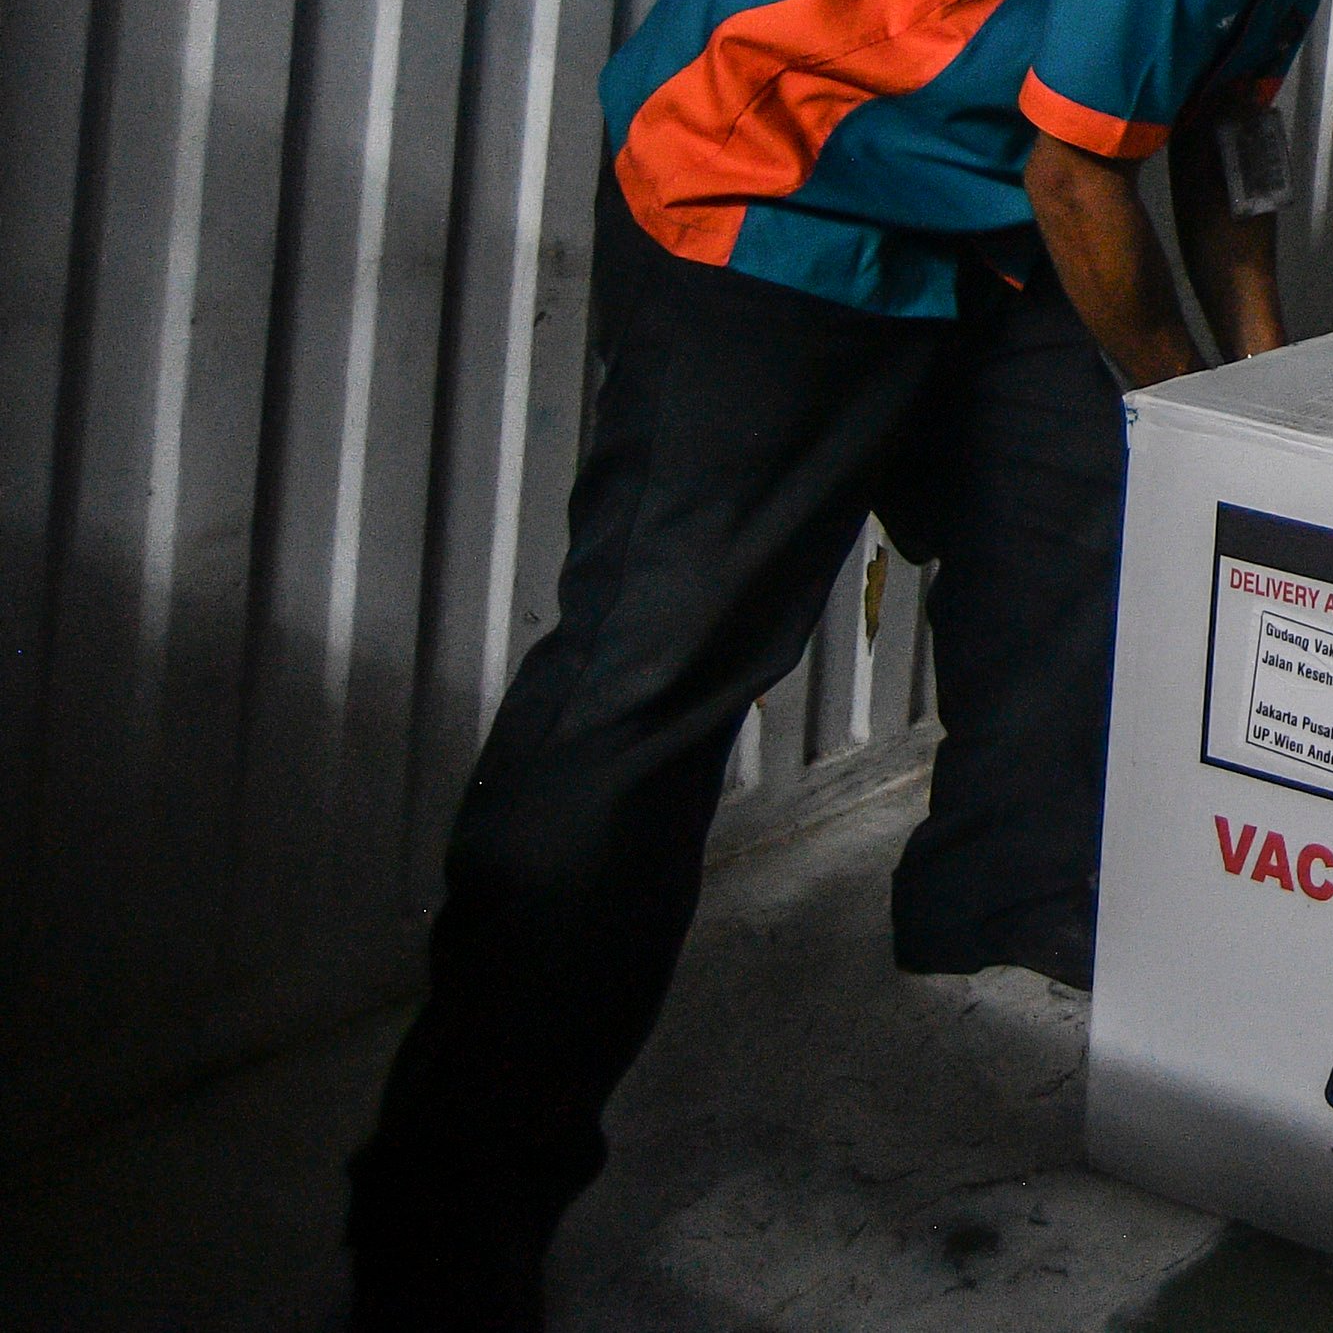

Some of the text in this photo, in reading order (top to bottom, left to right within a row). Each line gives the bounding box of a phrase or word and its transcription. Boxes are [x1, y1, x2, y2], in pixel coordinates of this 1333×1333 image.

[1229, 568, 1320, 609] DELIVERY
[1266, 622, 1310, 652] Gudang
[1262, 650, 1293, 672] Jalan
[1255, 701, 1298, 727] Jakarta
[1253, 724, 1304, 754] UP.Wien
